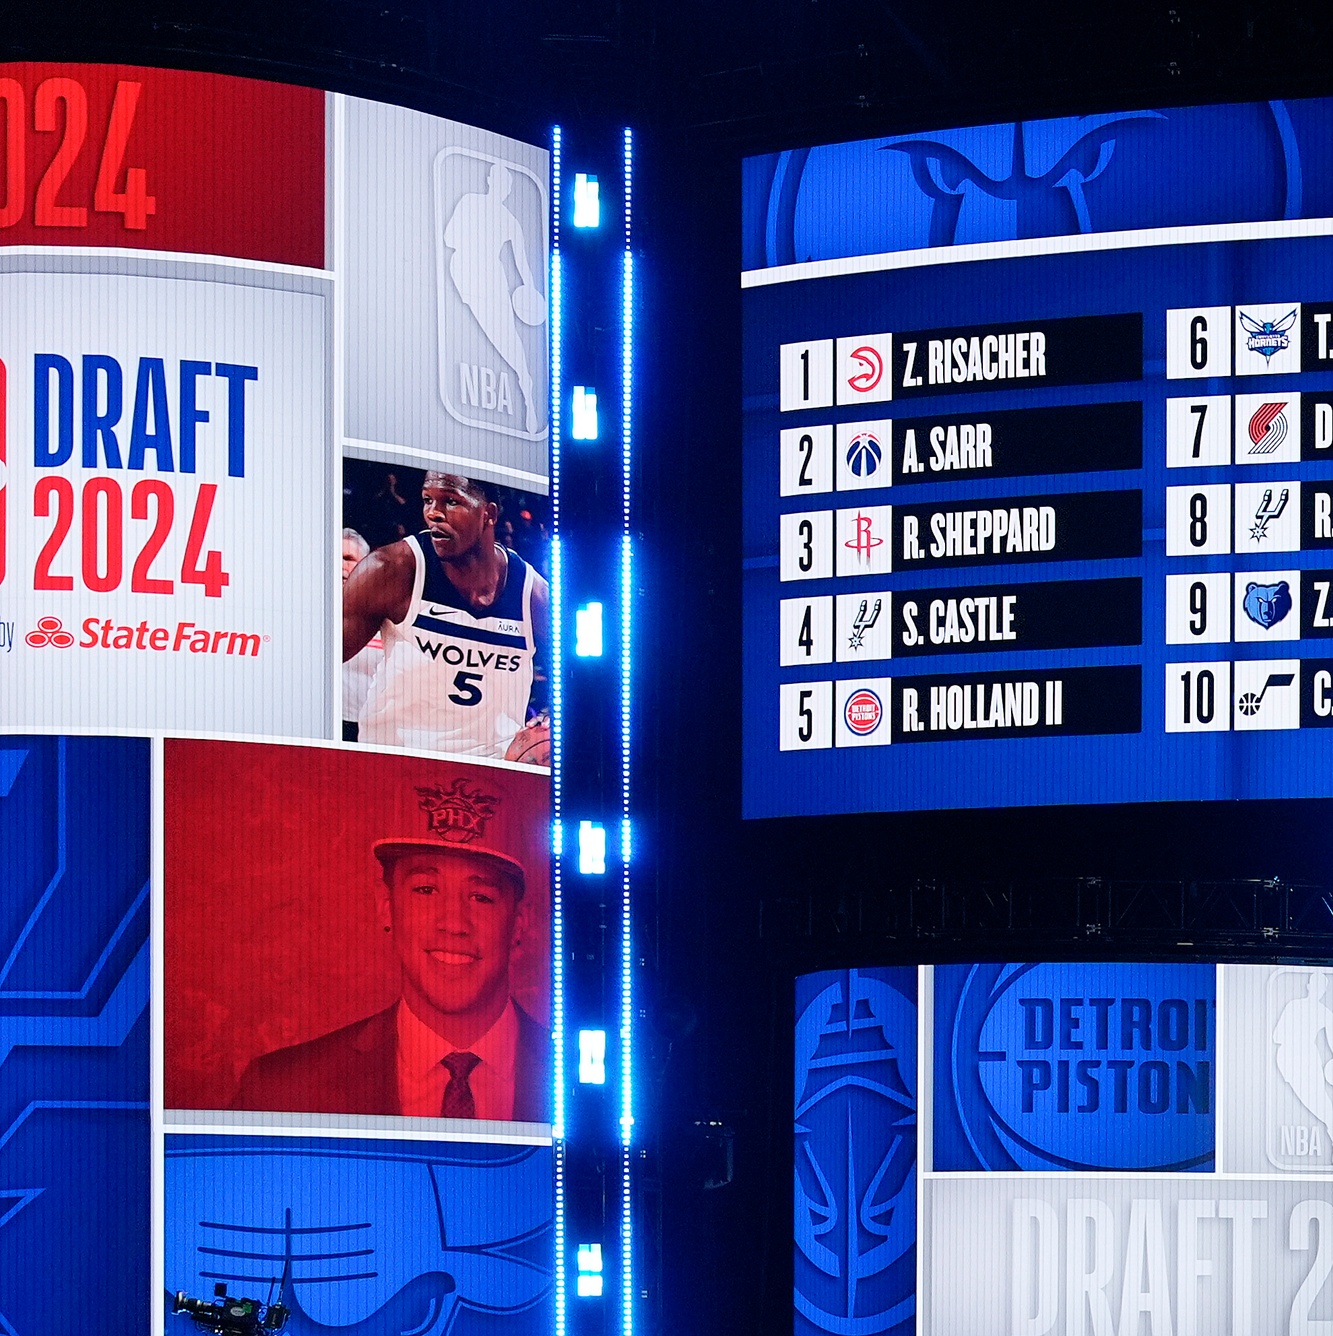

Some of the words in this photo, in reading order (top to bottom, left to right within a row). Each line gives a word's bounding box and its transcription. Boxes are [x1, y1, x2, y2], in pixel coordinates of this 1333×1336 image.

[801, 350, 808, 400] 1
[903, 343, 922, 387] Z.
[929, 332, 1046, 384] RISACHER
[1191, 316, 1207, 369] 6
[1248, 335, 1288, 348] HORNETS
[460, 362, 513, 416] NBA
[34, 354, 258, 478] DRAFT
[1191, 405, 1207, 458] 7
[799, 435, 812, 486] 2
[903, 429, 924, 473] A.
[930, 424, 992, 471] SARR
[33, 476, 229, 597] 2024
[799, 520, 812, 571] 3
[904, 516, 924, 559] R.
[930, 507, 1055, 557] SHEPPARD
[1190, 493, 1207, 547] 8
[799, 606, 813, 656] 4
[903, 602, 924, 646] S.
[930, 596, 1016, 644] CASTLE
[1190, 582, 1206, 635] 9
[80, 618, 169, 650] State
[173, 622, 260, 656] Farm
[415, 636, 521, 672] WOLVES
[448, 671, 483, 706] 5
[799, 691, 812, 742] 5
[903, 688, 924, 732] R.
[931, 682, 1039, 730] HOLLAND
[1046, 681, 1062, 725] II
[1181, 670, 1214, 723] 10
[432, 809, 481, 832] PHX
[1019, 1060, 1210, 1114] PISTON
[1281, 1126, 1322, 1158] NBA
